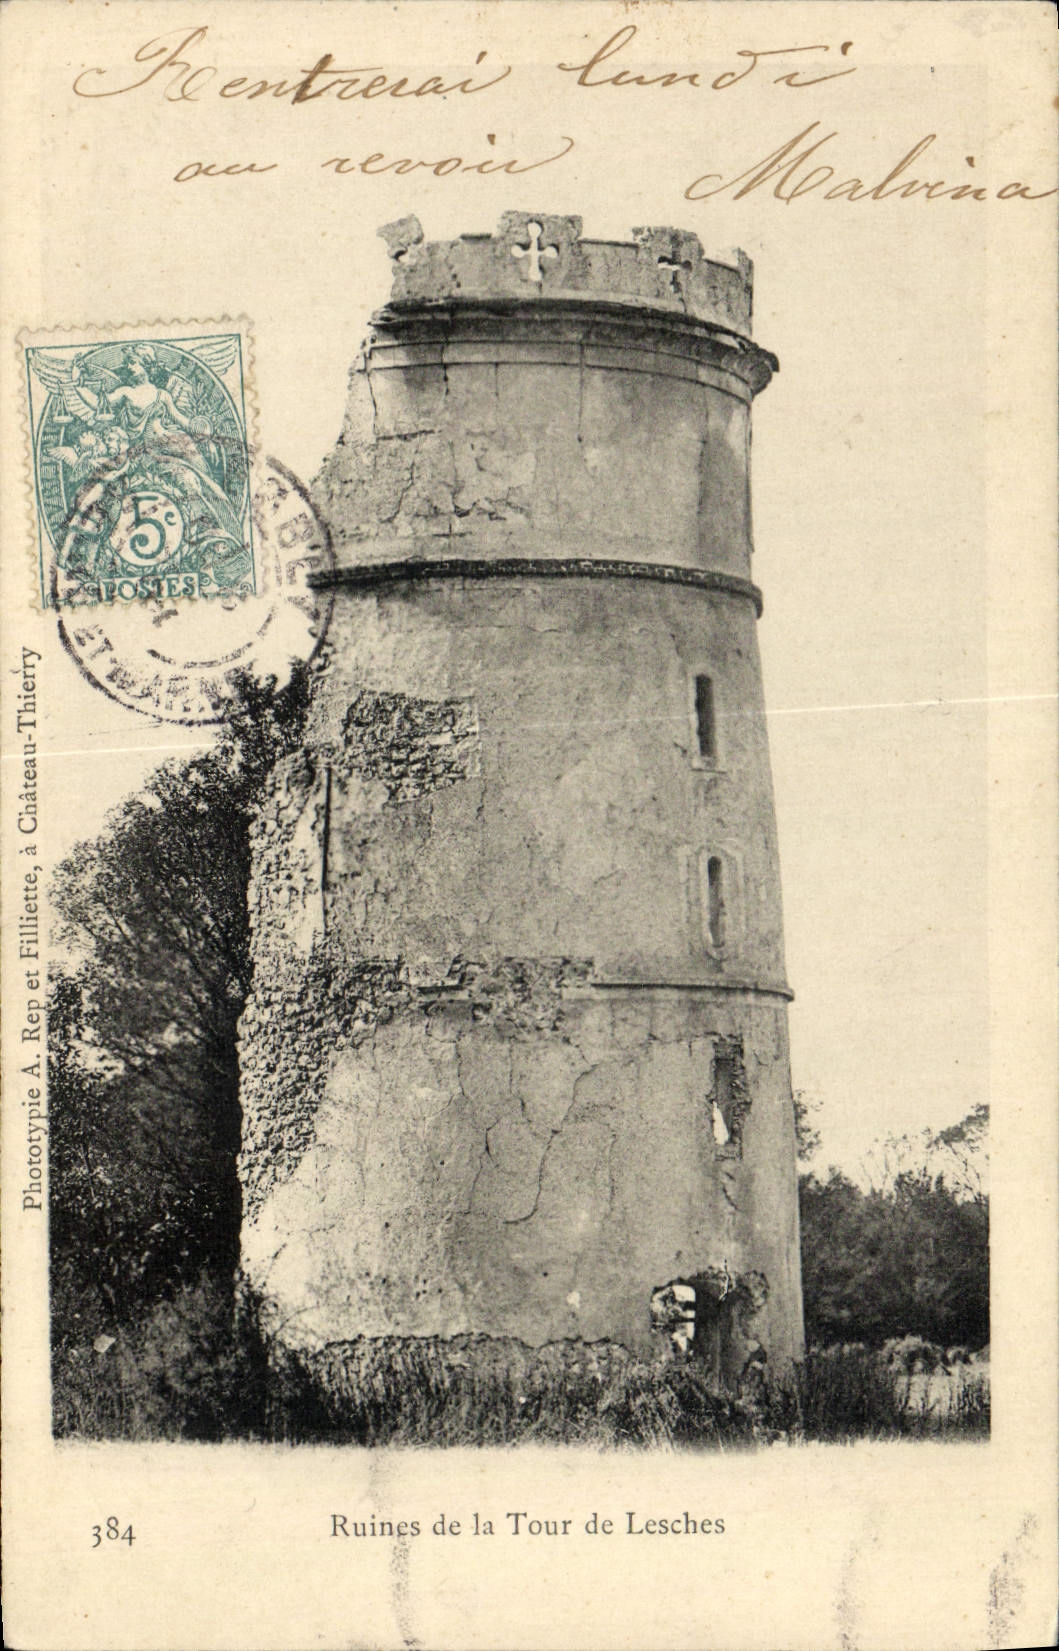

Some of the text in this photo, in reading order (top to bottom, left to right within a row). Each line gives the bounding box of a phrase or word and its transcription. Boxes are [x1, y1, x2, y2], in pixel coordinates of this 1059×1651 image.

[557, 25, 856, 90] lundi
[174, 121, 1059, 205] au revoir Malvina
[101, 575, 195, 602] POSTES
